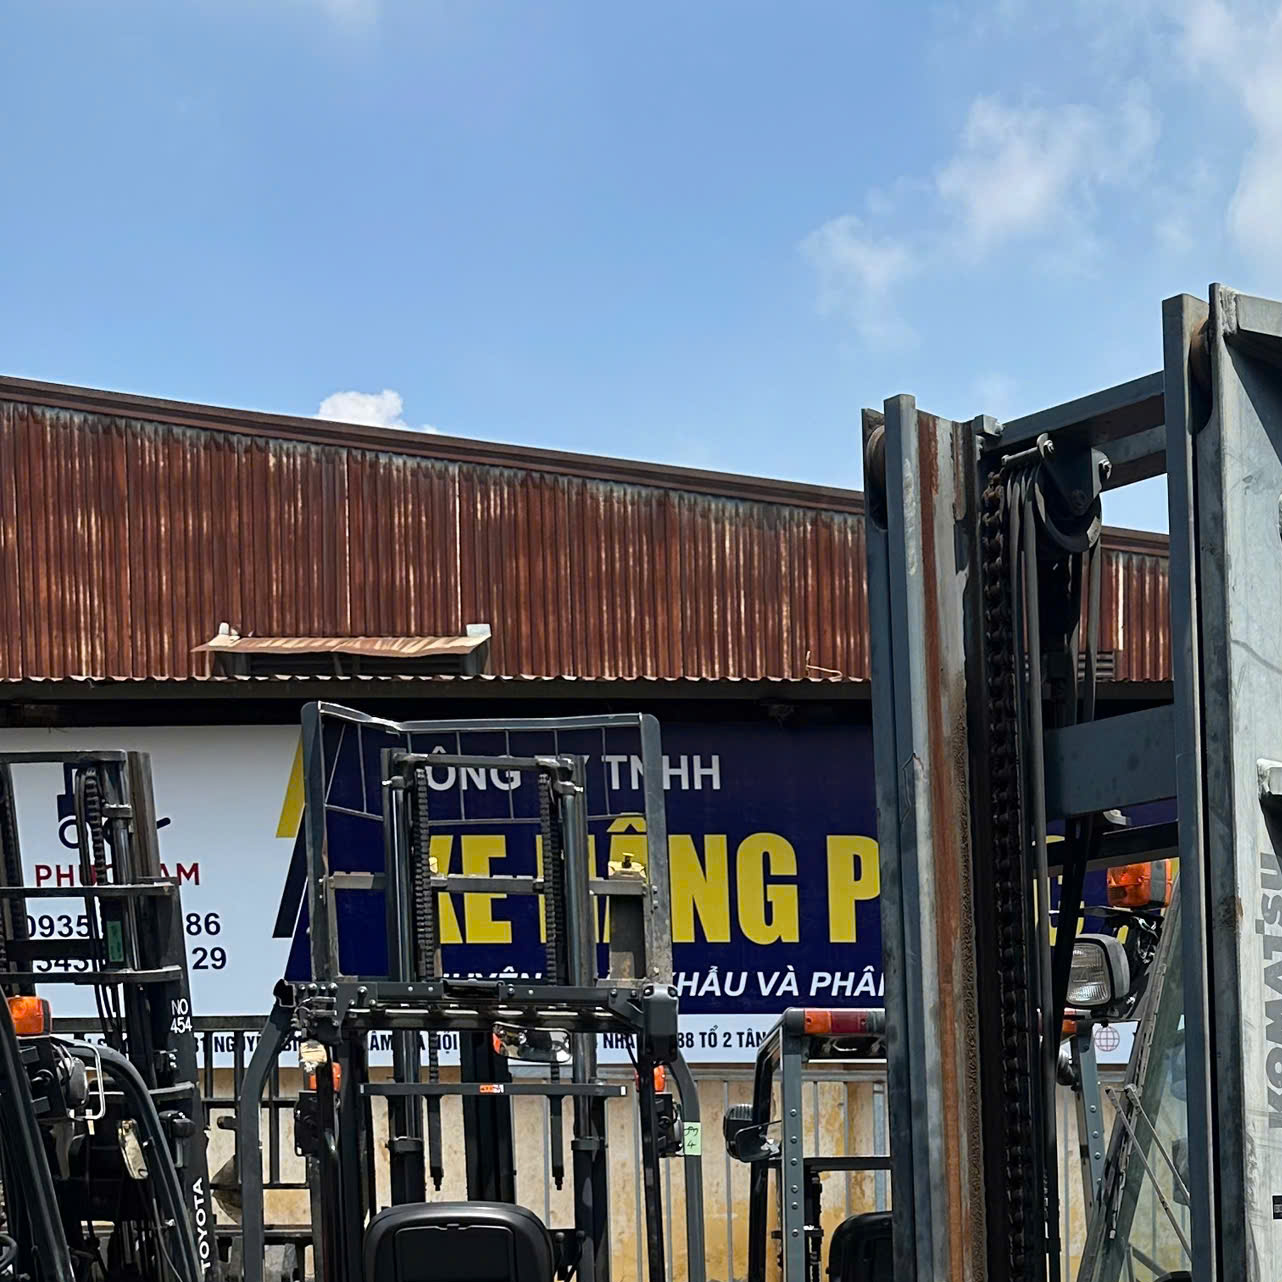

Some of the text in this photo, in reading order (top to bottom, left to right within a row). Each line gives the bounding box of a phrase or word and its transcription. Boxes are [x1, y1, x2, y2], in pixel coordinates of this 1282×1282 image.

[672, 965, 748, 997] HẨU
[757, 965, 800, 996] VÀ
[171, 998, 189, 1015] NO
[170, 1016, 193, 1034] 454
[699, 1024, 718, 1048] TỔ
[722, 1032, 732, 1048] 2
[192, 1177, 211, 1274] TOYOTA
